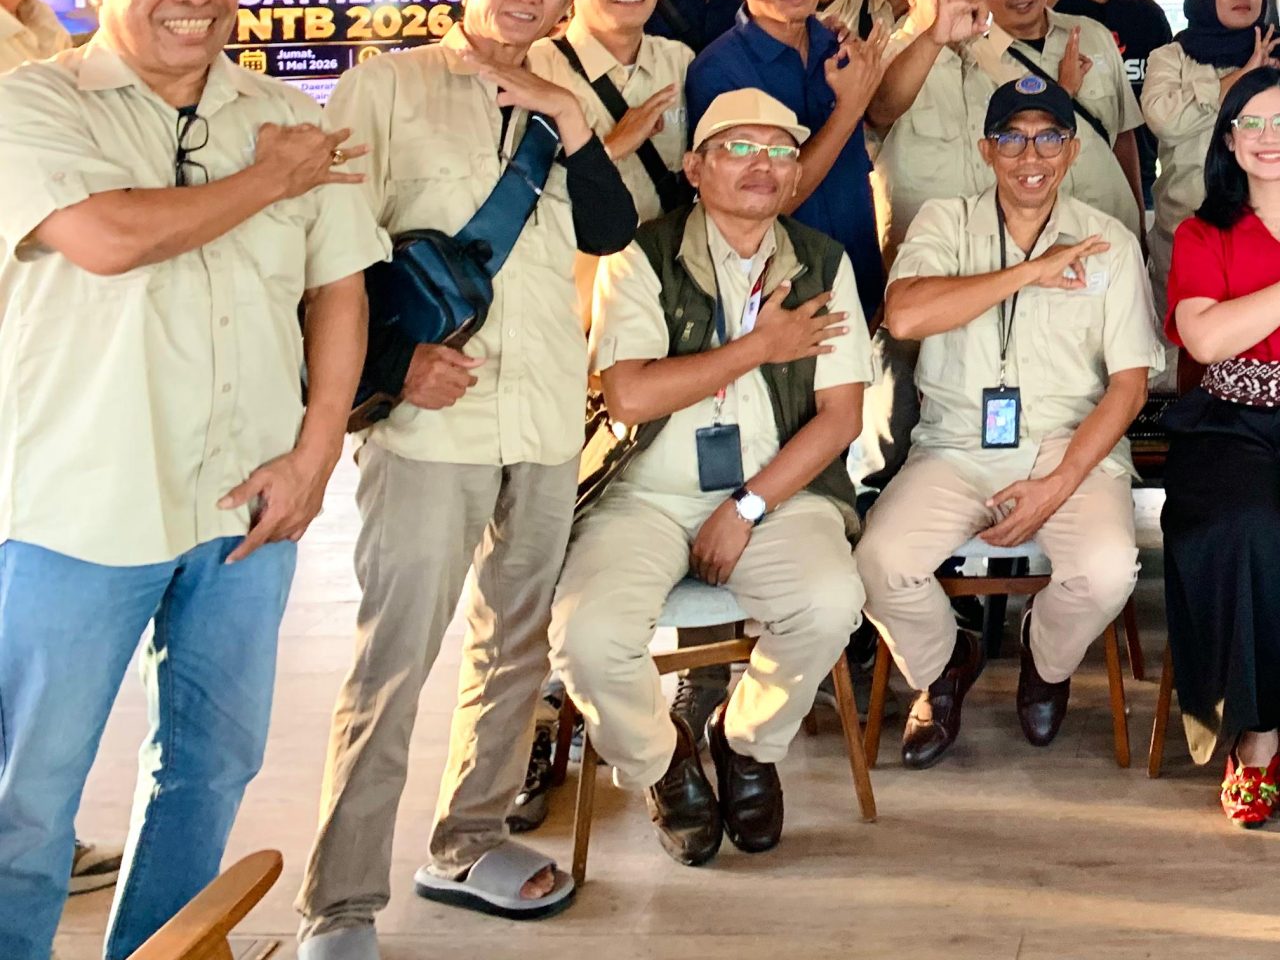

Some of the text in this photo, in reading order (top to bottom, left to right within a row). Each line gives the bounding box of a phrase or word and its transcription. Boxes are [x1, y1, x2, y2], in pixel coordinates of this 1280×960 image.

[237, 4, 455, 42] NTB 2026
[276, 49, 316, 60] Jumat,
[277, 59, 338, 71] 1 Mei 2026
[1124, 58, 1146, 80] SI
